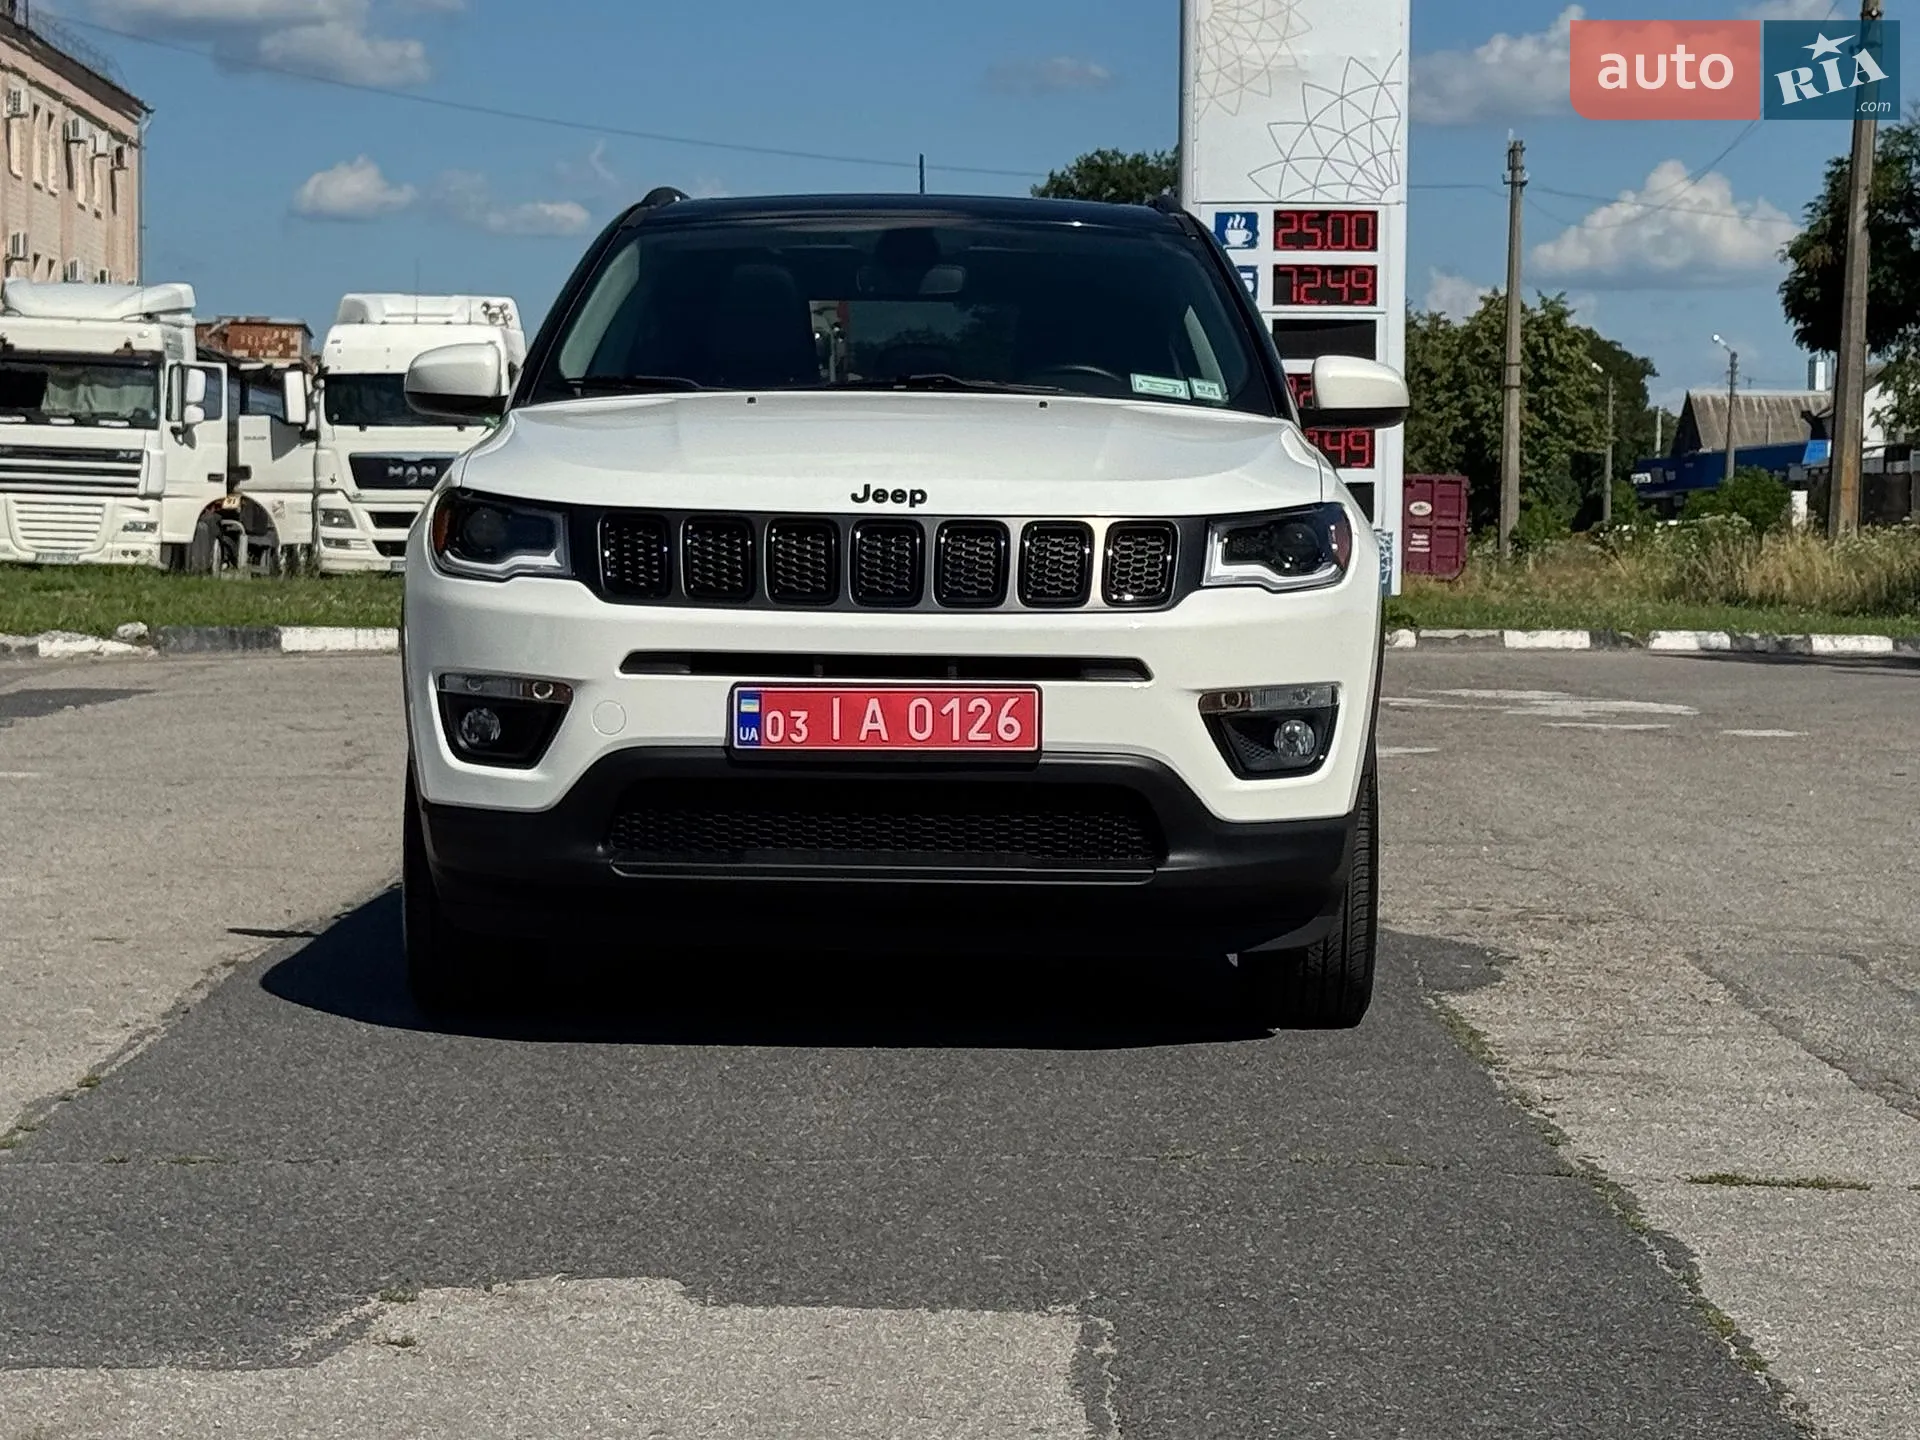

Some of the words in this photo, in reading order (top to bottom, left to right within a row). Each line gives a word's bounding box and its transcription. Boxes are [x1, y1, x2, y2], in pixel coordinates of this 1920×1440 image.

[1277, 213, 1374, 250] 25.00
[1278, 266, 1374, 304] 72.49
[387, 465, 437, 477] MAN
[850, 483, 928, 508] Jeep
[740, 727, 758, 741] UA
[766, 709, 809, 743] 03
[907, 696, 1023, 742] 0126
